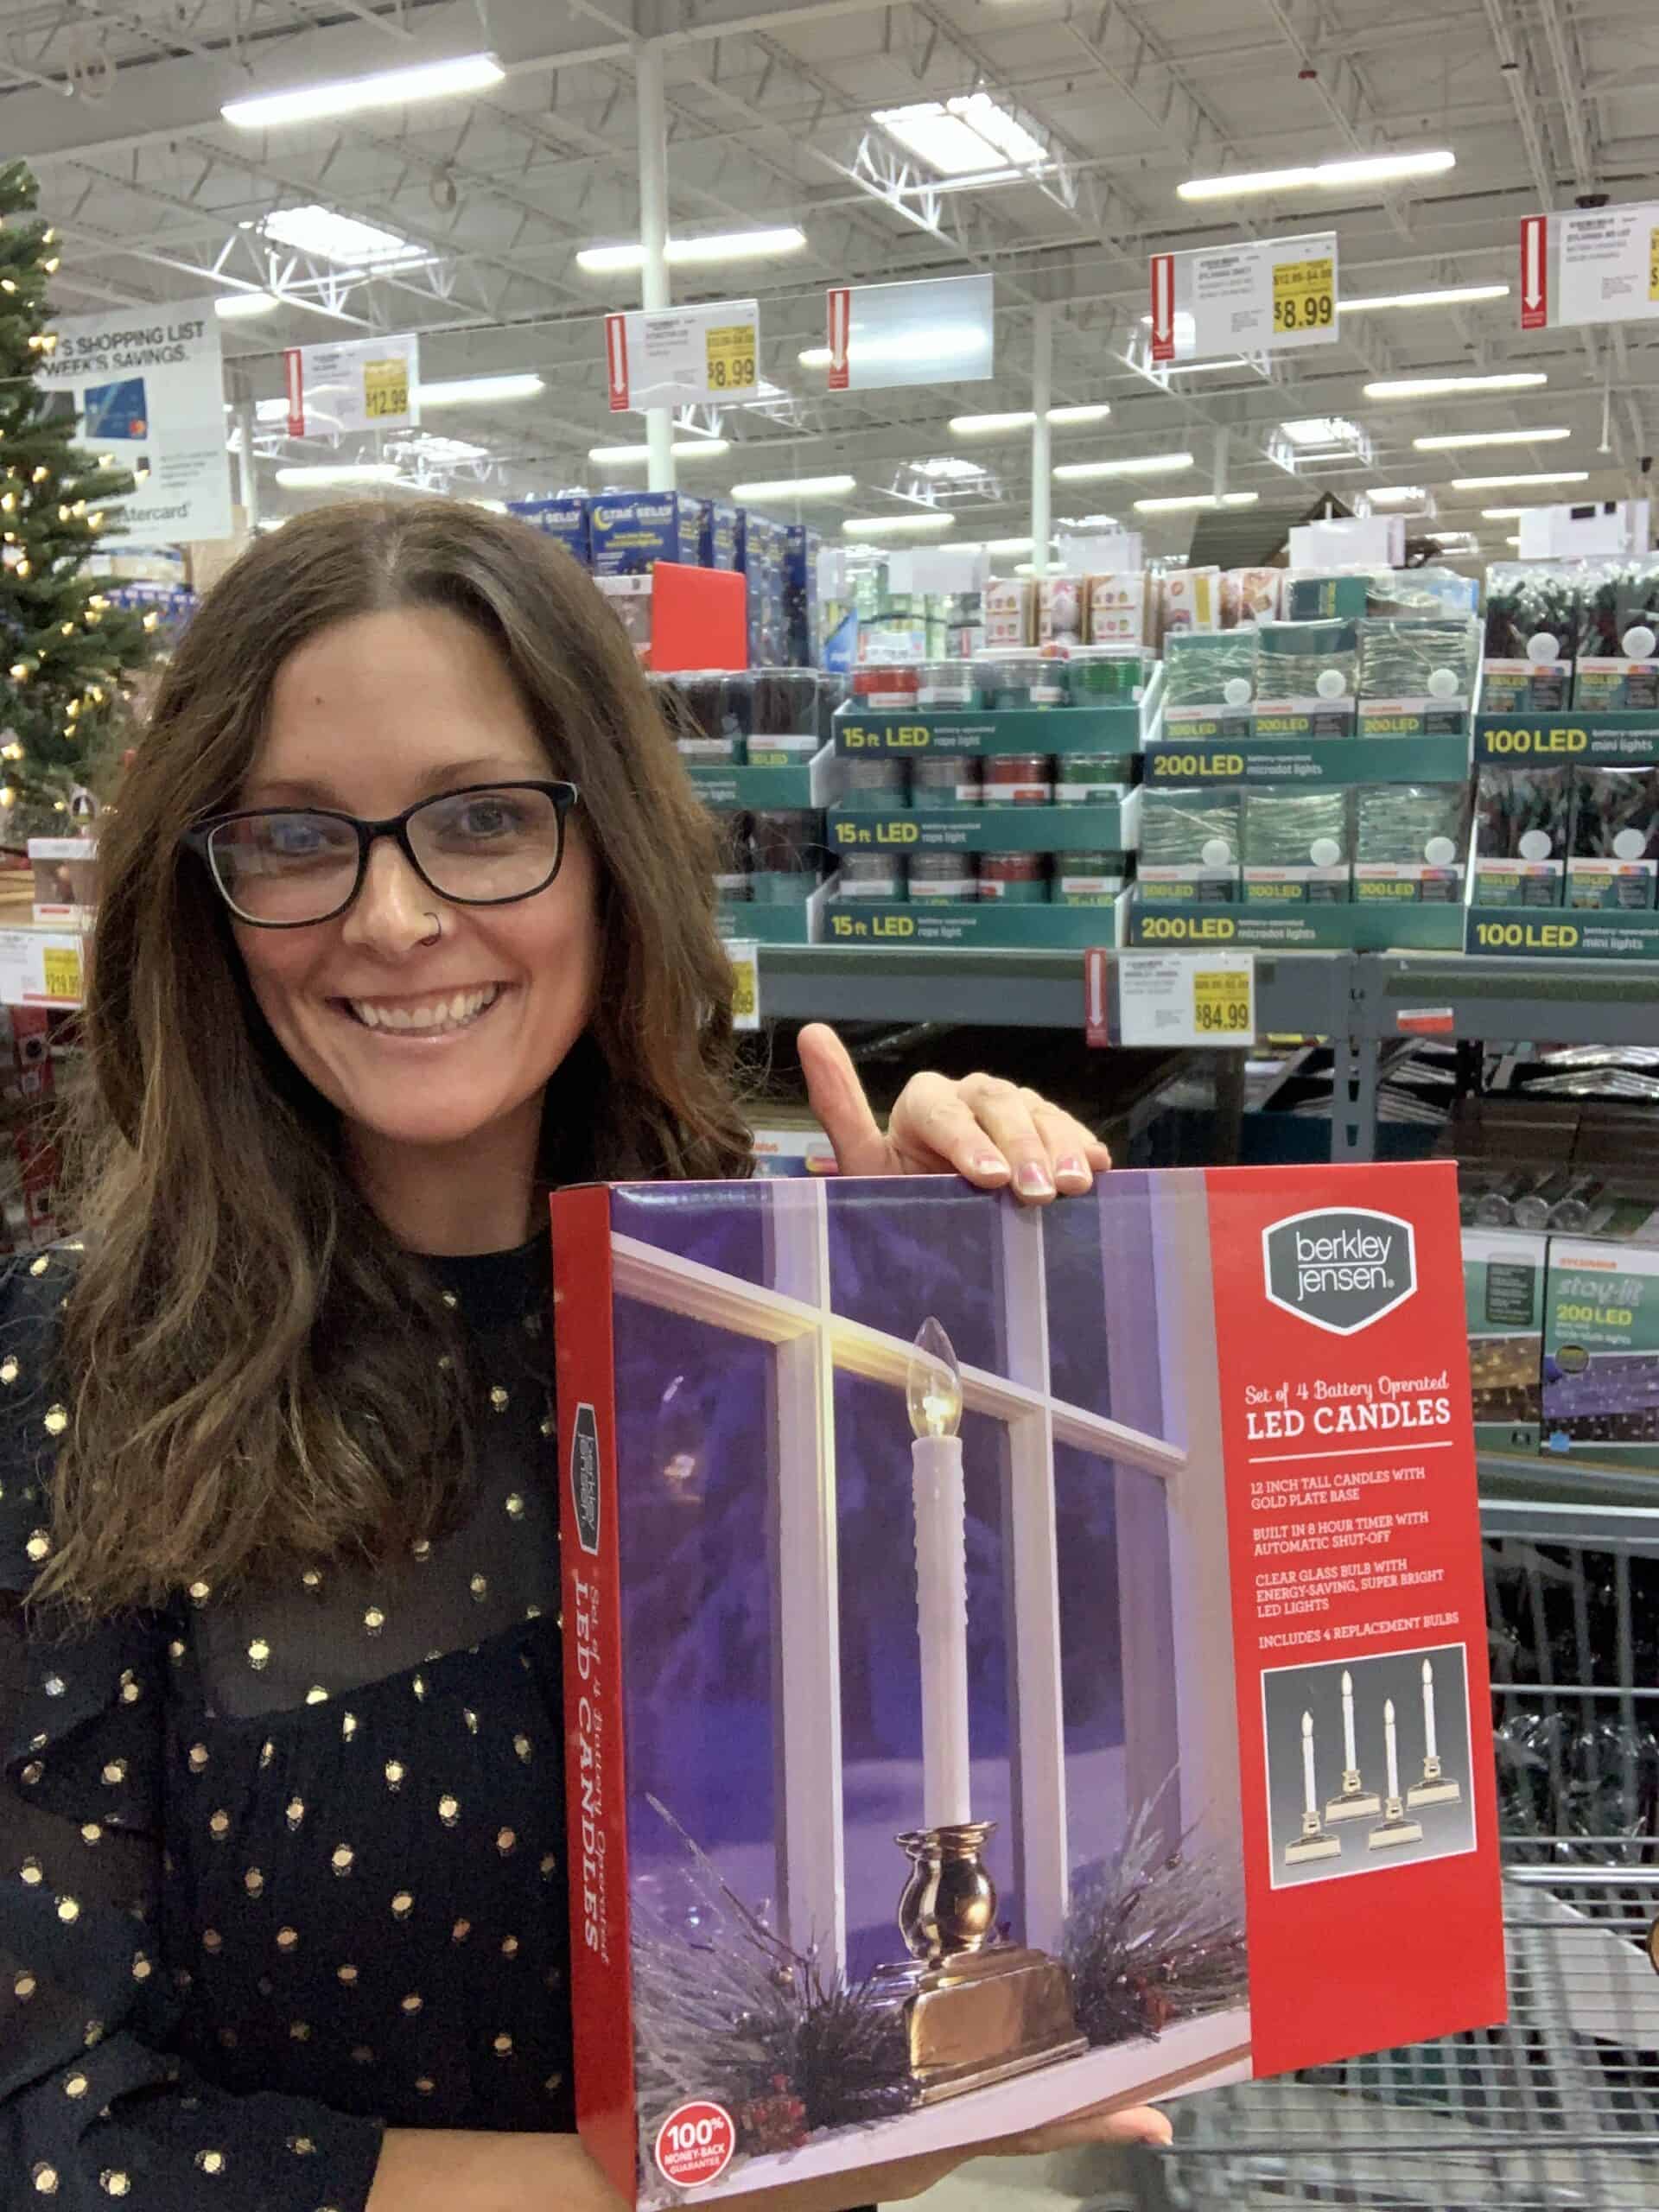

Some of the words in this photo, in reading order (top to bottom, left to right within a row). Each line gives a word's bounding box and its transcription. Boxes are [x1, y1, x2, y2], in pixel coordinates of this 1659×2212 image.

[1274, 296, 1332, 327] $8.99
[76, 327, 163, 354] SHOPPING
[168, 321, 206, 340] LIST
[708, 359, 755, 387] $8.99
[365, 389, 408, 416] $12.99
[886, 727, 930, 747] LED
[876, 823, 918, 843] LED
[873, 916, 914, 937] LED
[1195, 1002, 1249, 1030] $84.99
[1296, 1228, 1392, 1264] berkley
[1297, 1266, 1388, 1301] jensen
[1244, 1384, 1272, 1406] Set
[1275, 1382, 1289, 1408] of
[1296, 1383, 1309, 1400] 4
[1313, 1379, 1373, 1403] Battery
[1378, 1370, 1450, 1401] Operated
[1246, 1410, 1306, 1440] LED
[1313, 1398, 1452, 1435] CANDLES
[1250, 1481, 1265, 1496] 12
[1266, 1478, 1300, 1493] INCH
[1300, 1475, 1332, 1491] TALL
[1333, 1470, 1390, 1488] CANDLES
[1393, 1466, 1426, 1481] WITH
[1251, 1495, 1287, 1510] GOLD
[1289, 1491, 1328, 1508] PLATE
[1330, 1487, 1361, 1503] BASE
[1253, 1524, 1289, 1541] BUILT
[1291, 1523, 1306, 1537] IN
[1307, 1522, 1316, 1535] 8
[1318, 1518, 1354, 1535] HOUR
[1355, 1515, 1395, 1530] TIMER
[1395, 1510, 1430, 1526] WITH
[1254, 1535, 1329, 1557] AUTOMATIC
[1332, 1529, 1392, 1549] SHUT-OFF
[1255, 1571, 1298, 1587] CLEAR
[1299, 1567, 1338, 1583] GLASS
[1340, 1562, 1372, 1578] BULB
[1373, 1558, 1408, 1574] WITH
[1256, 1580, 1360, 1604] ENERGY-SAVING,
[1361, 1574, 1398, 1592] SUPER
[1400, 1568, 1446, 1586] BRIGHT
[1256, 1603, 1282, 1618] LED
[1283, 1598, 1330, 1616] LIGHTS
[575, 1580, 591, 1681] LED
[1258, 1629, 1322, 1649] INCLUDES
[1323, 1629, 1332, 1643] 4
[1332, 1616, 1422, 1640] REPLACEMENT
[1423, 1611, 1459, 1629] BULBS
[577, 1695, 600, 1953] CANDLES
[666, 2116, 725, 2152] 100%
[669, 2156, 721, 2176] GUARANTEE
